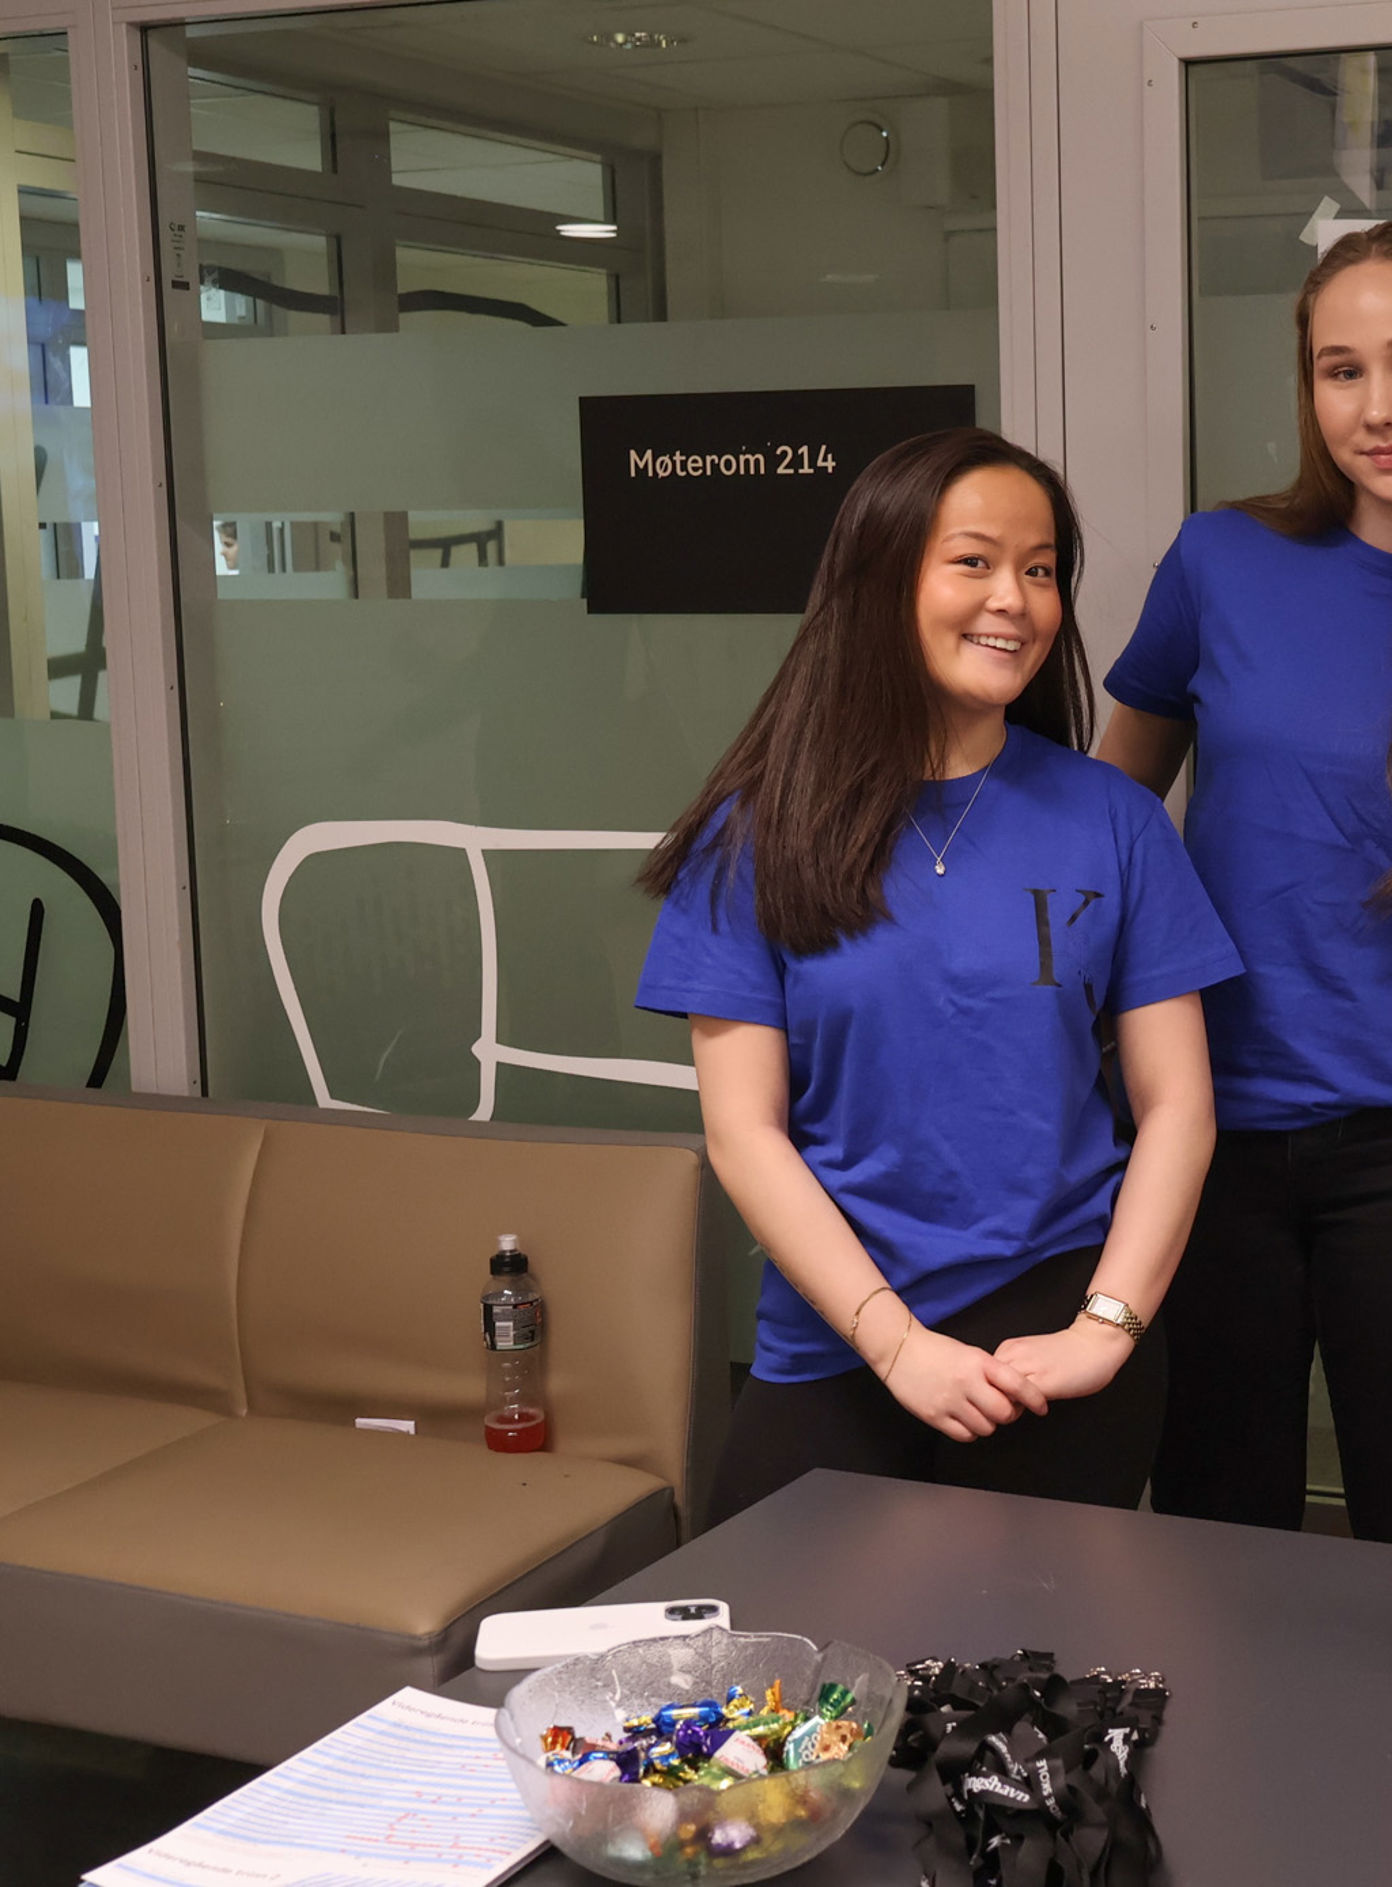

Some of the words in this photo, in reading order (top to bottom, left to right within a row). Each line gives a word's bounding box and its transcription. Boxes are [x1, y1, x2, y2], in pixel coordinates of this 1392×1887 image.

[629, 447, 766, 479] Møterom
[775, 444, 837, 475] 214
[1035, 1758, 1054, 1797] SKOLE
